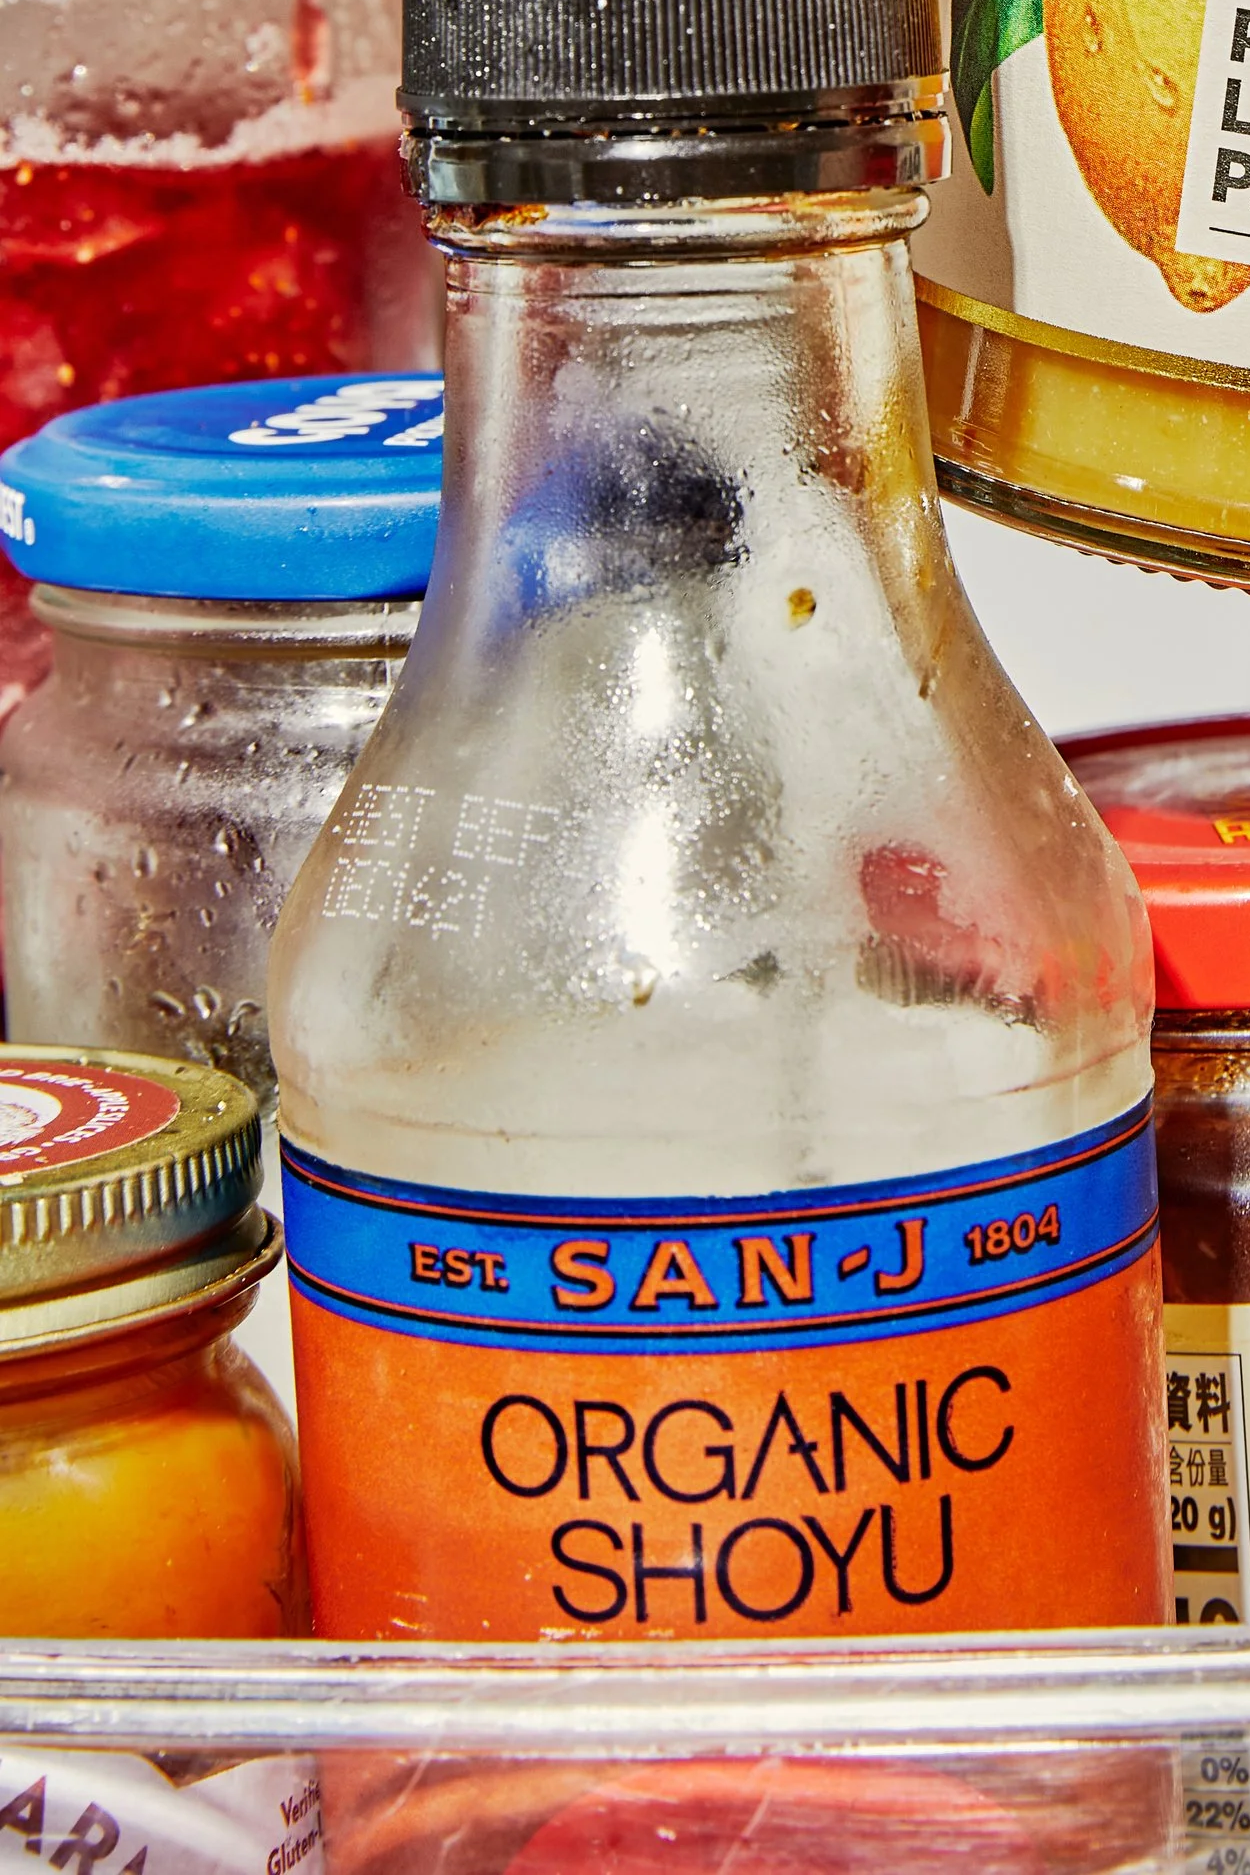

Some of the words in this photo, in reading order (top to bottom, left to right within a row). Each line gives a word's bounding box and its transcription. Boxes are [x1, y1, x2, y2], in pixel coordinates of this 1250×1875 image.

[52, 1112, 126, 1144] SLICES
[411, 1244, 509, 1293] EST.
[551, 1219, 929, 1312] SAN-J
[966, 1205, 1061, 1264] 1804
[482, 1364, 1014, 1503] ORGANIC
[551, 1494, 953, 1626] SHOYU
[1208, 1497, 1237, 1542] g)
